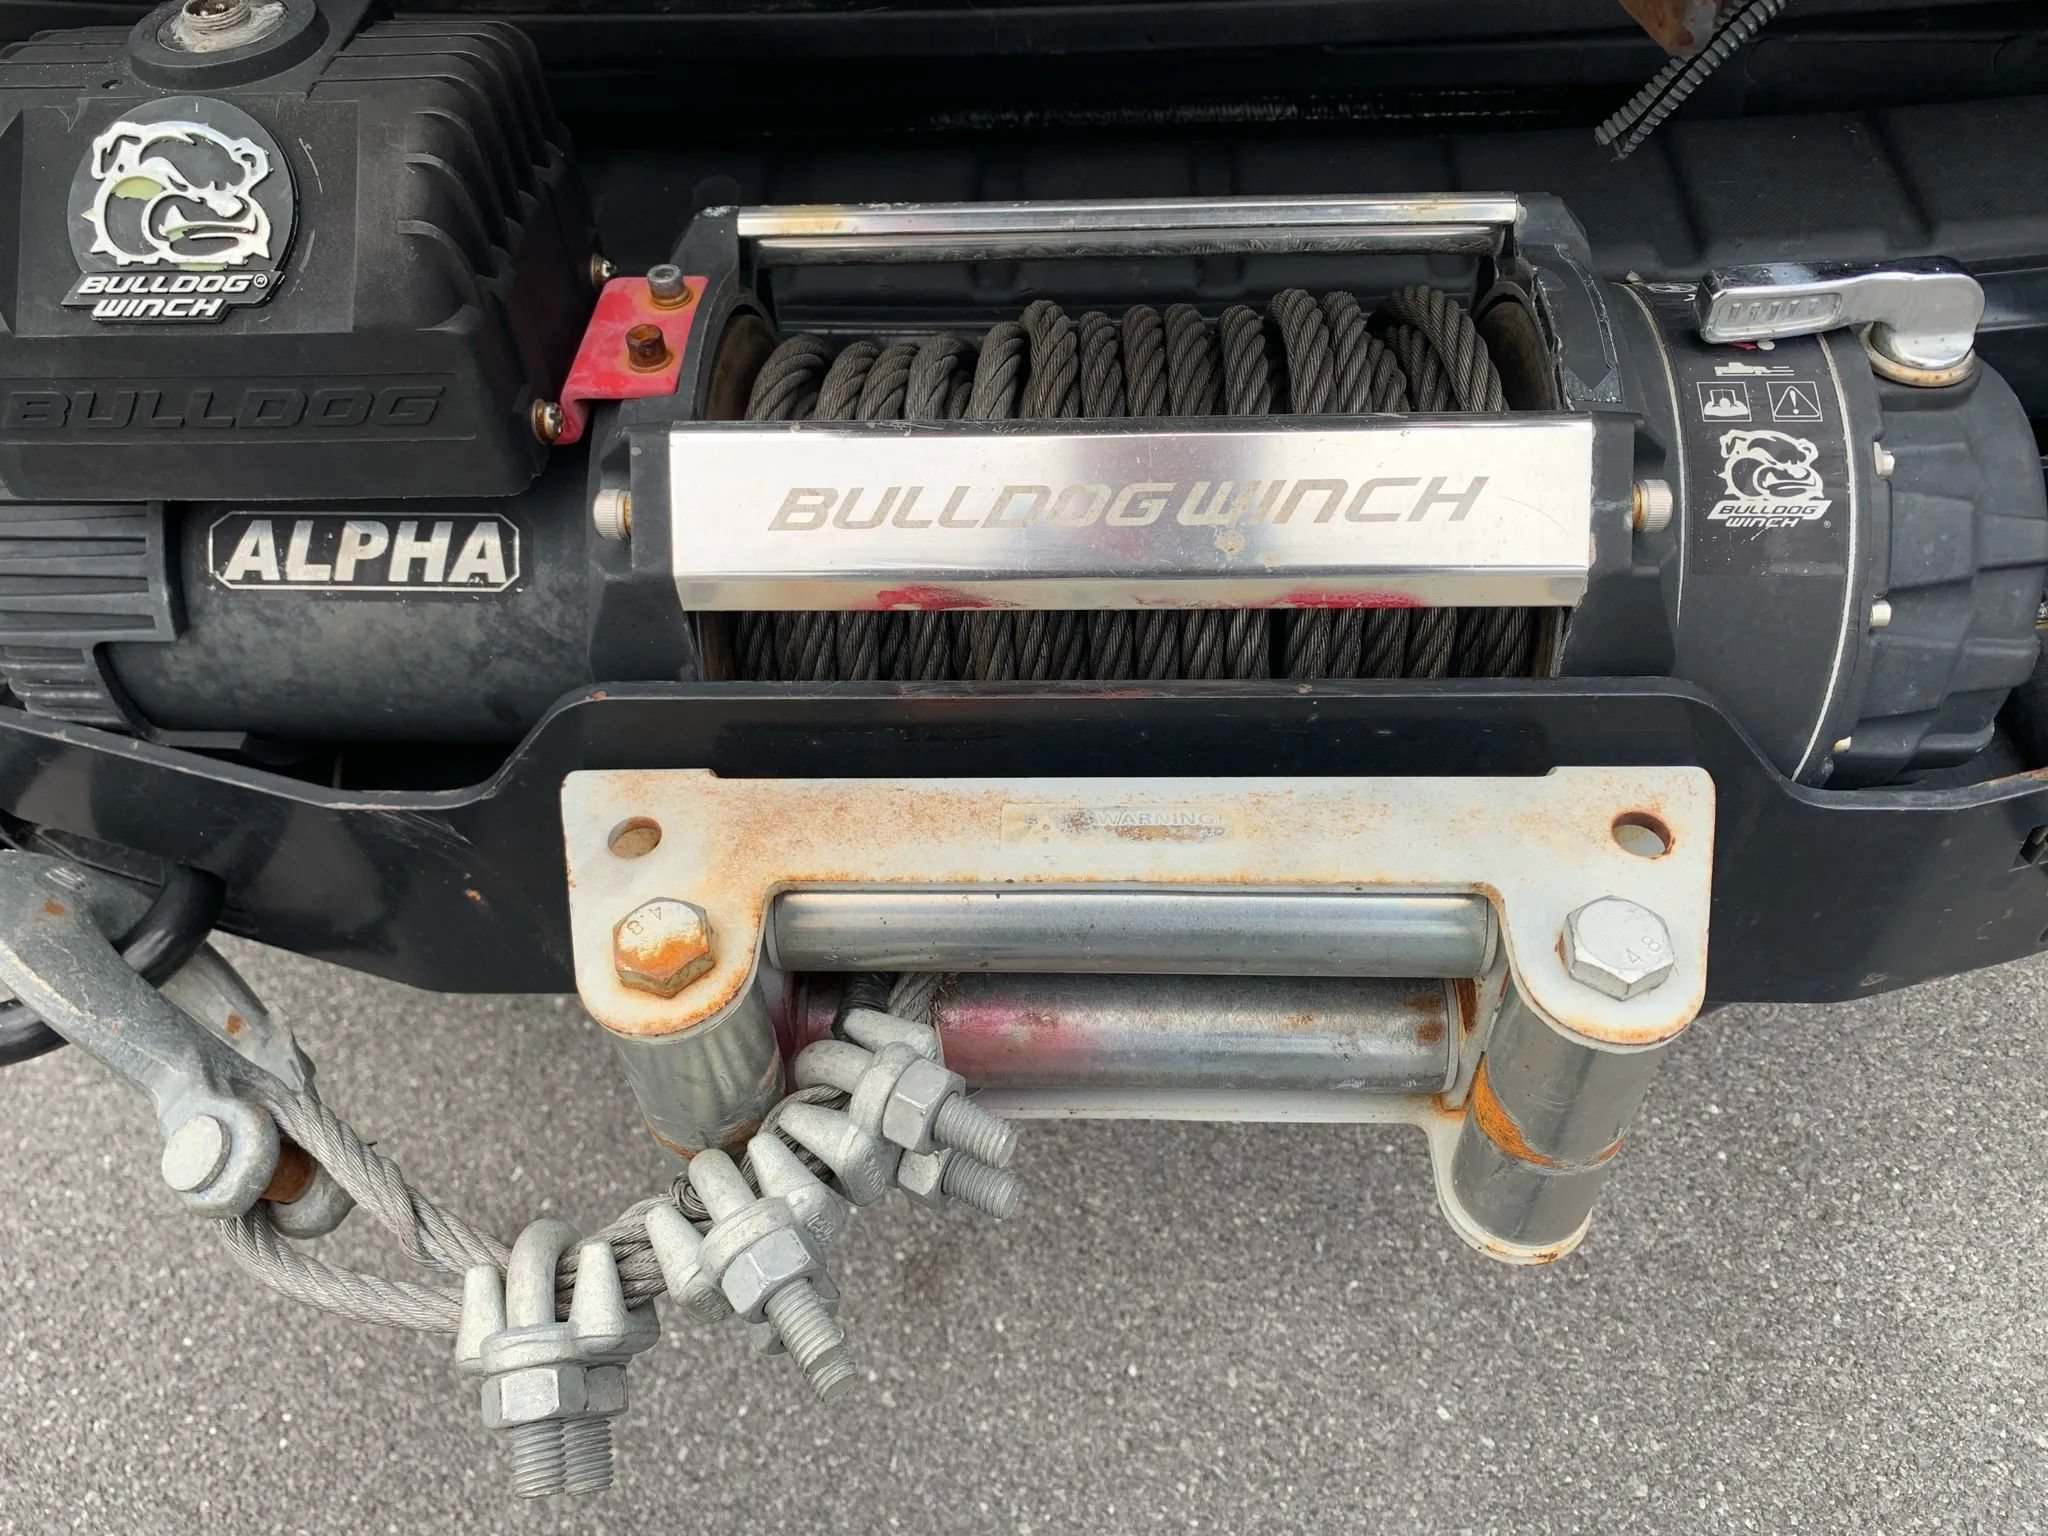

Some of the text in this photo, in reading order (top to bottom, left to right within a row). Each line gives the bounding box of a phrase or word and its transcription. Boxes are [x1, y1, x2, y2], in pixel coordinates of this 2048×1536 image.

[92, 299, 223, 317] WINCH
[4, 387, 446, 428] BULLDOG
[1718, 505, 1819, 515] BULLDOG
[1725, 516, 1800, 528] WINCH
[221, 519, 508, 583] ALPHA
